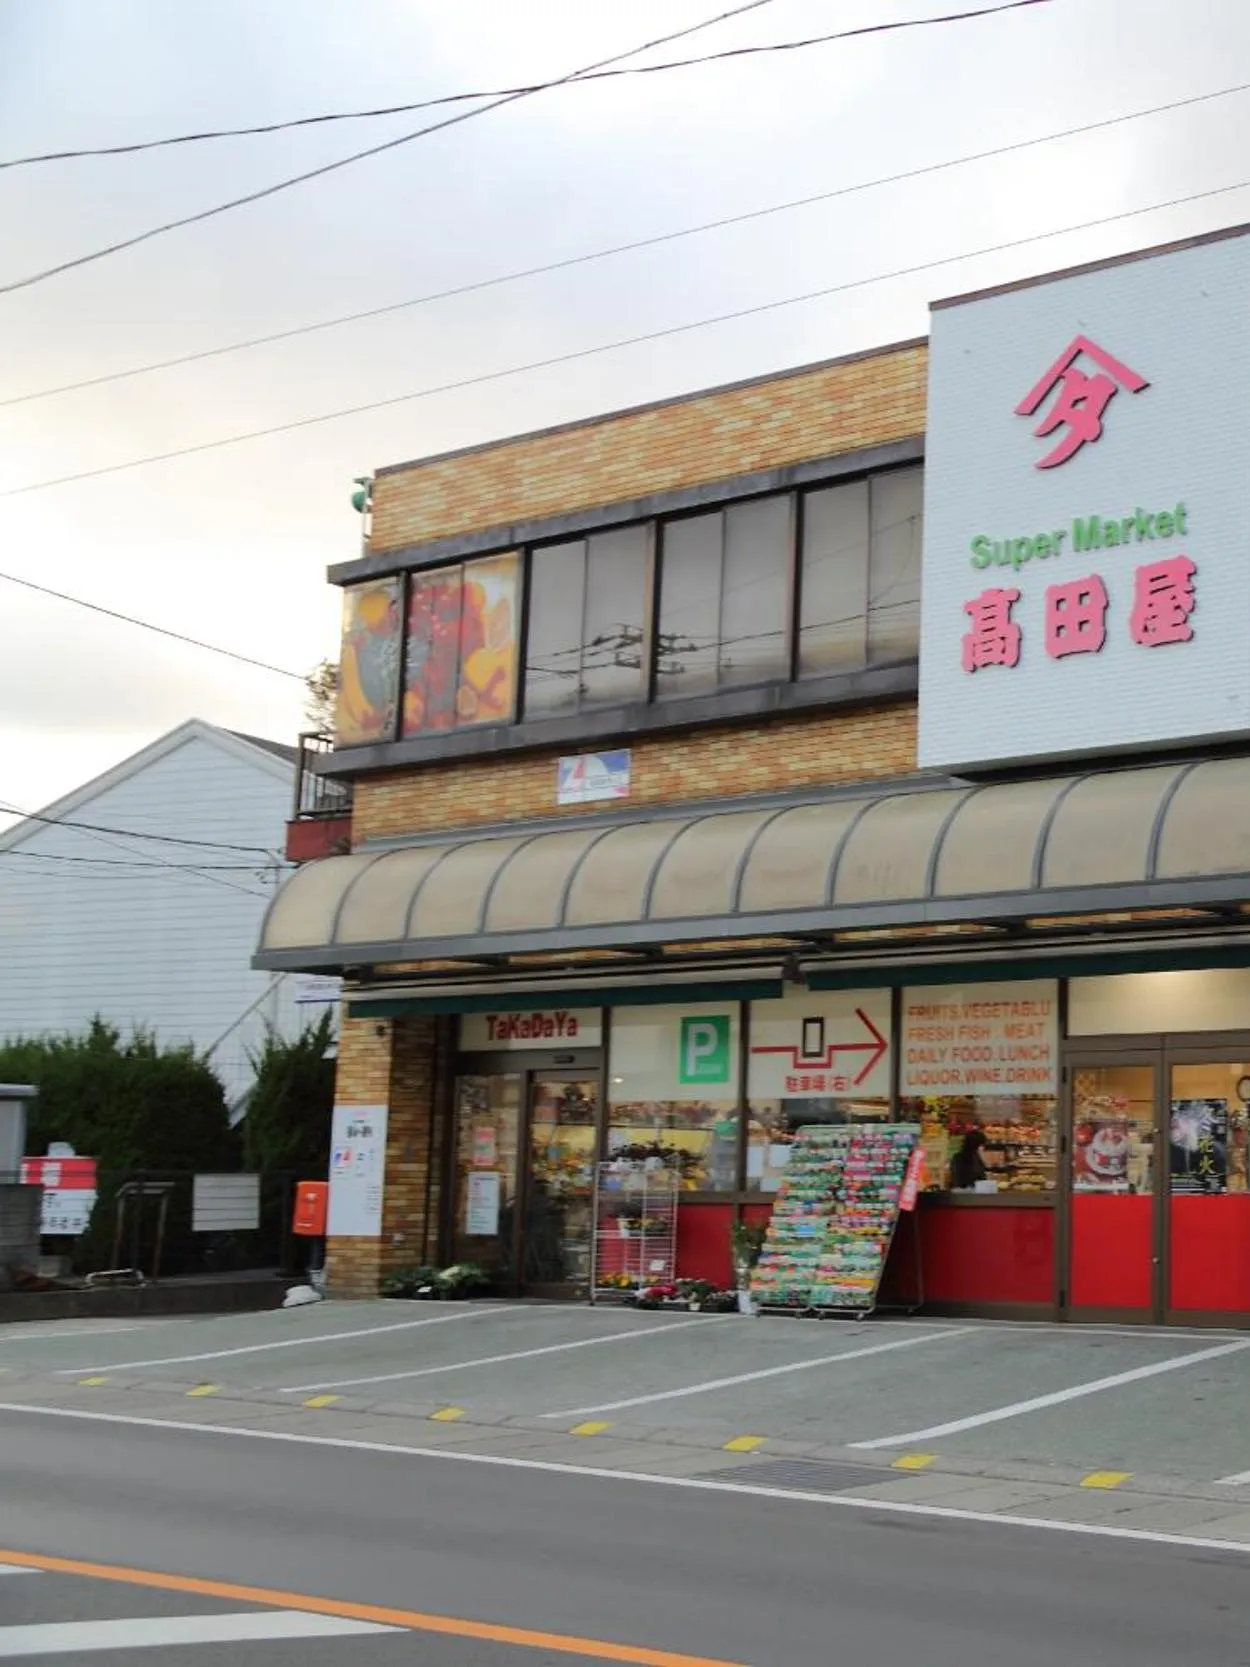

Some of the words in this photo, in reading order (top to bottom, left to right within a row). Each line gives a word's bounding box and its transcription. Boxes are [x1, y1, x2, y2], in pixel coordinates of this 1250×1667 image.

[970, 533, 1067, 572] Super
[1072, 501, 1188, 553] Market
[486, 1010, 578, 1041] TaKaDaYa
[687, 1023, 719, 1077] P
